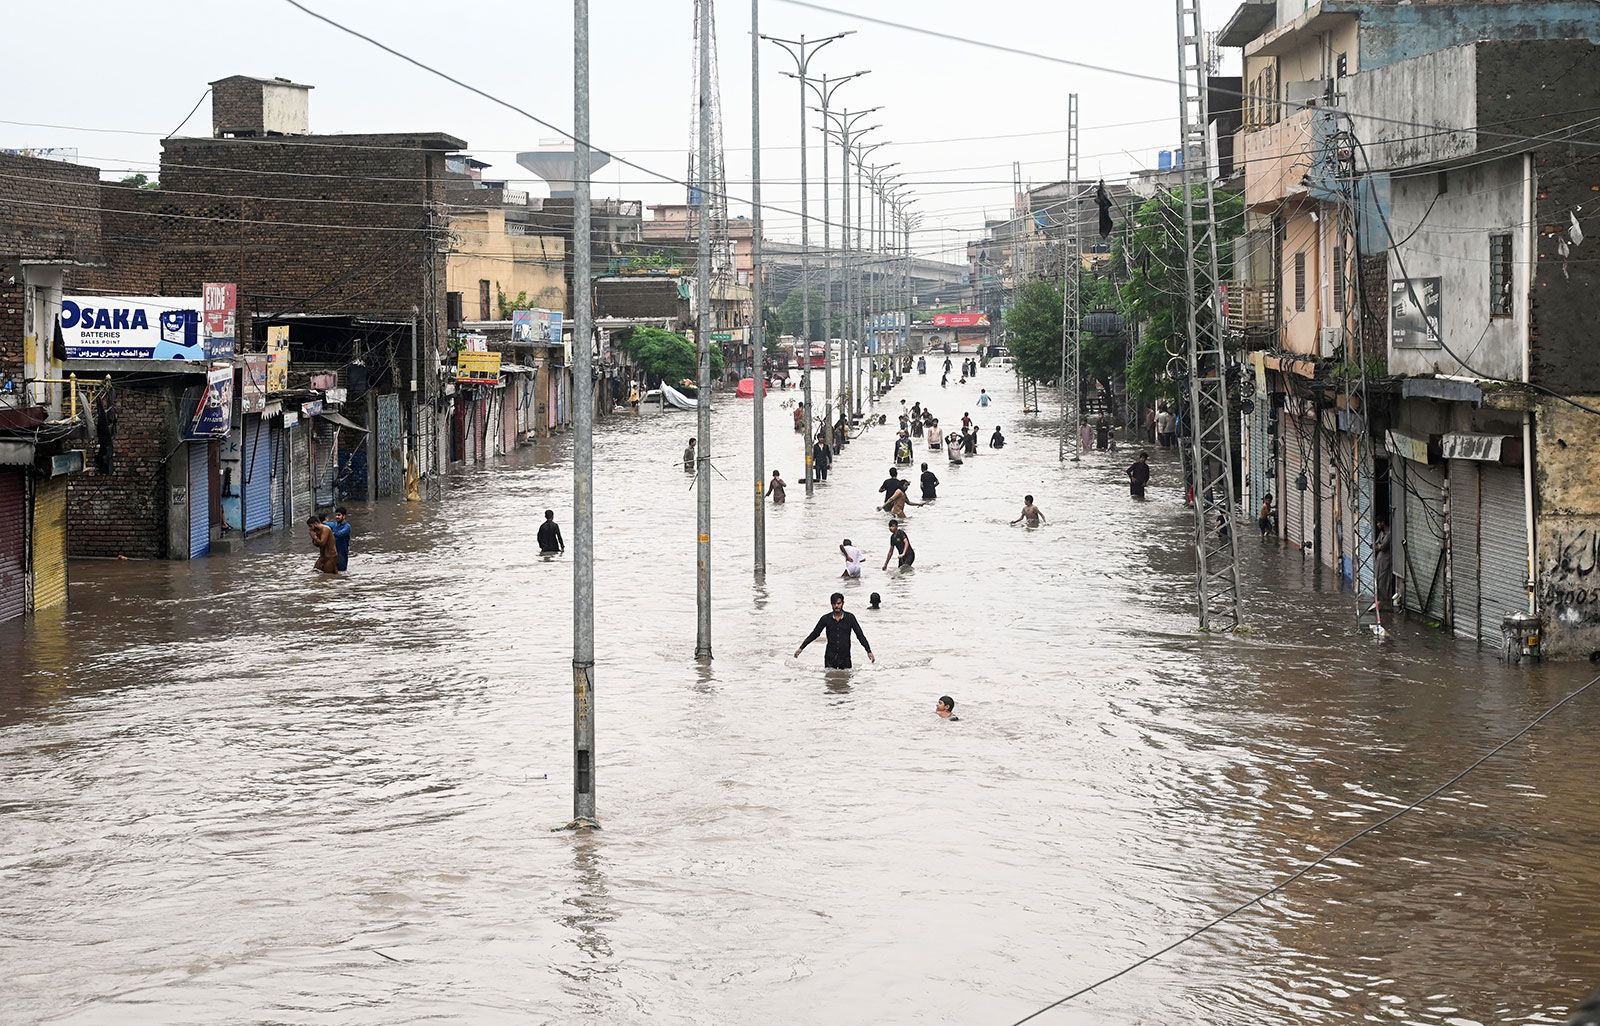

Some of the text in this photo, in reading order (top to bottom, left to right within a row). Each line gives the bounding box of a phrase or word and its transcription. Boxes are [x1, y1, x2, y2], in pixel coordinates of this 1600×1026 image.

[206, 286, 225, 310] EXIDE
[62, 300, 149, 330] OSAKA
[80, 331, 121, 339] BATTERIES
